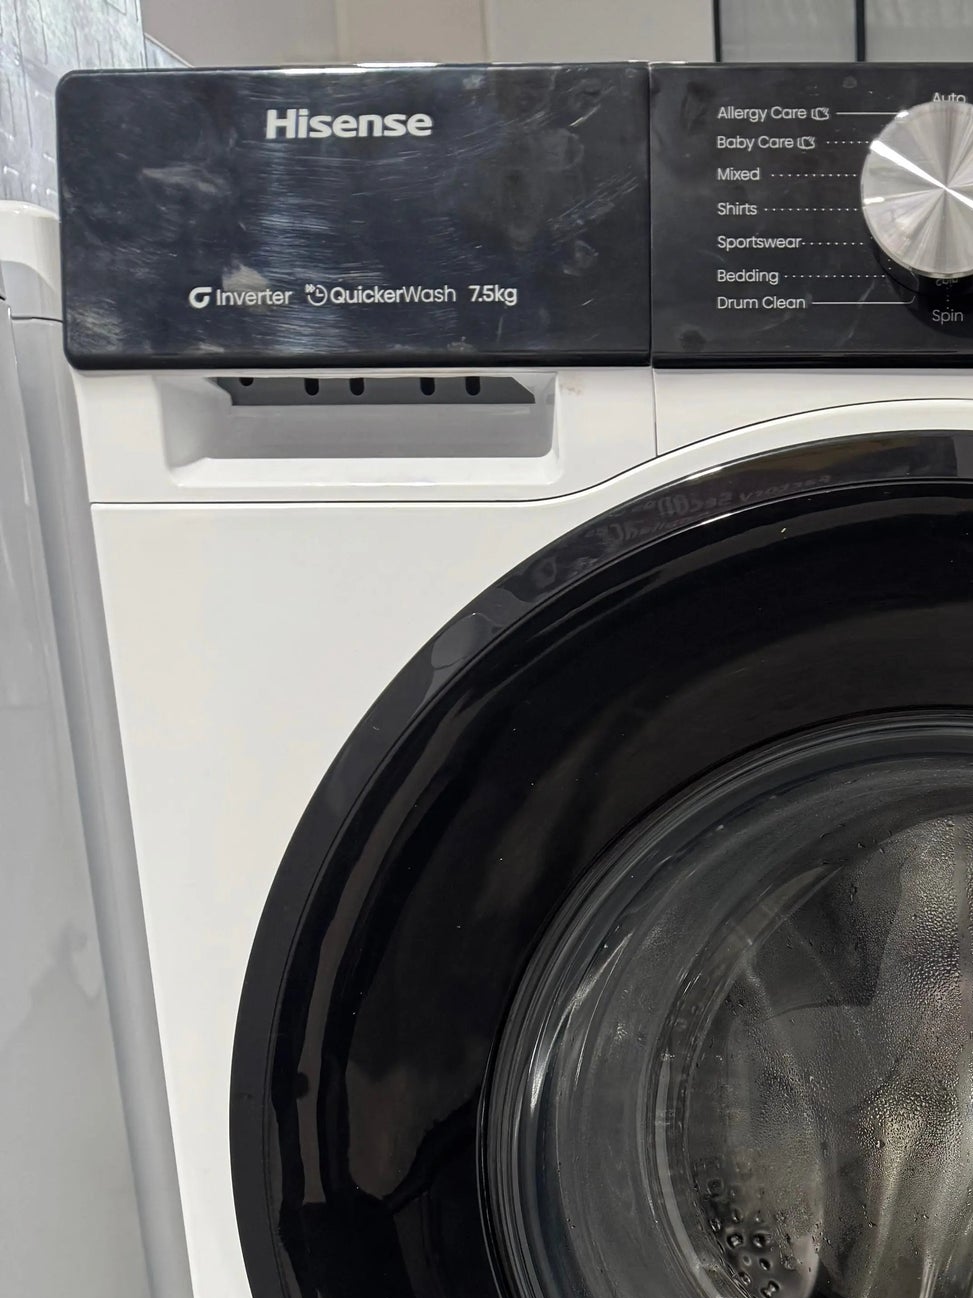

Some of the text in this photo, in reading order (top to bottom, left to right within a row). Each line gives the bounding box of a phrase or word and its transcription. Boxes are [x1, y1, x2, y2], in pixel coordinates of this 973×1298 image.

[932, 92, 967, 104] Auto
[717, 106, 807, 123] Allergy Care
[265, 108, 434, 140] Hisense
[716, 135, 794, 152] Baby Care
[717, 167, 761, 181] Mixed
[717, 202, 758, 216] Shirts
[717, 235, 802, 251] Sportswear
[717, 269, 779, 285] Bedding
[215, 284, 518, 307] Inverter QuickerWash 7.5kg
[717, 296, 806, 309] Drum Clean
[931, 308, 964, 324] Spin
